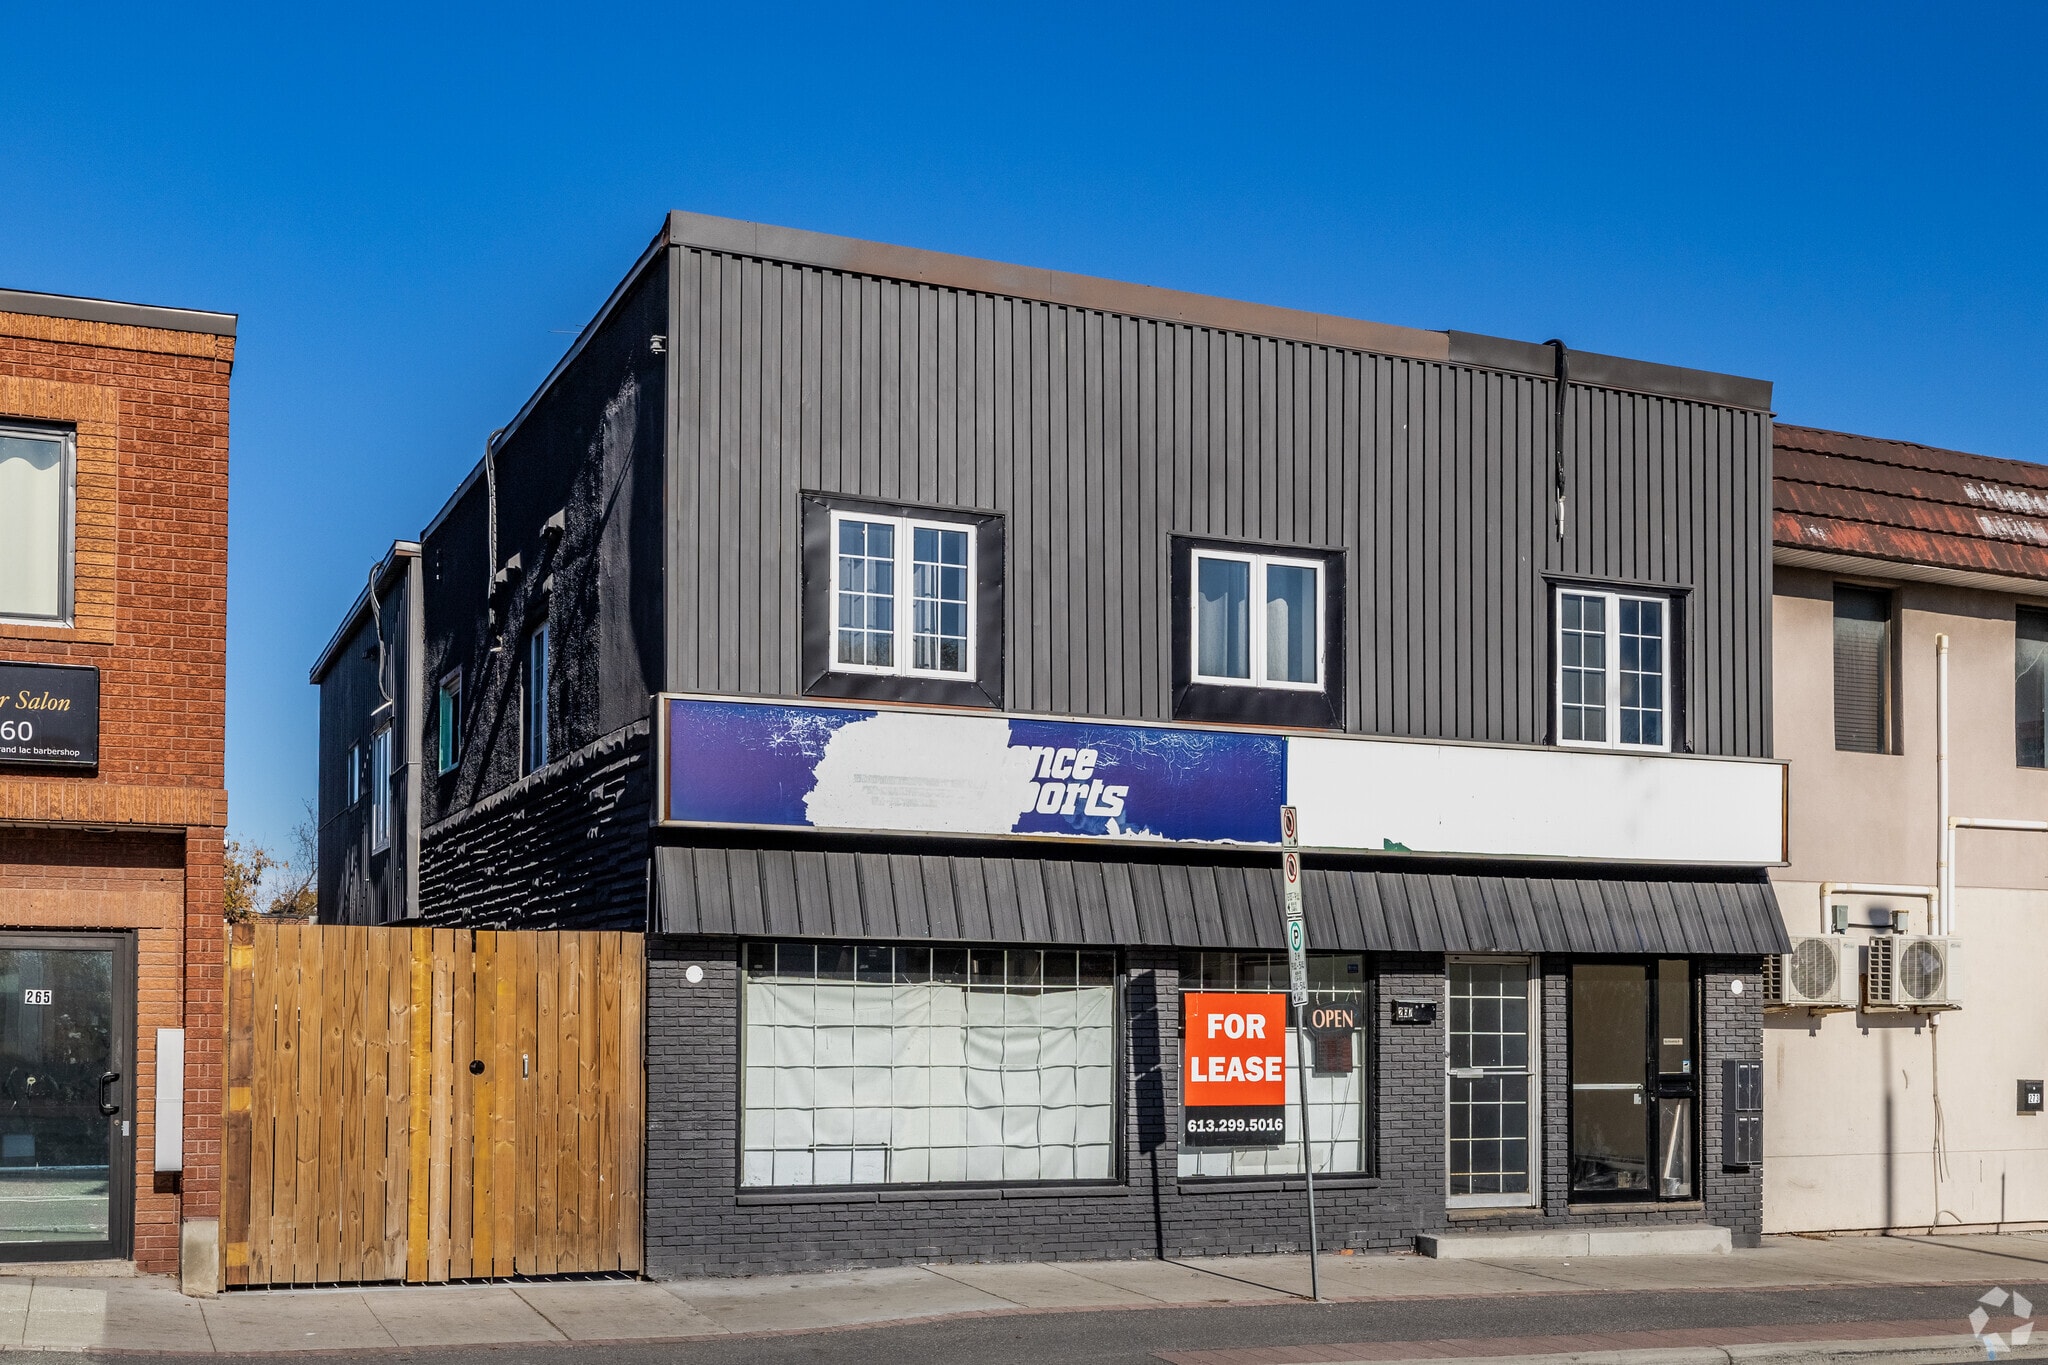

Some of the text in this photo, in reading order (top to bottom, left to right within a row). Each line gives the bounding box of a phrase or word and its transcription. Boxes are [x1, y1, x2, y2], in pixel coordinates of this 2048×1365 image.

[15, 690, 71, 712] Salon
[0, 720, 33, 741] 60
[19, 746, 31, 754] lac
[33, 747, 80, 758] barbershop
[26, 990, 50, 1004] 265
[1207, 1013, 1266, 1039] FOR
[1312, 1009, 1354, 1028] OPEN
[1191, 1056, 1283, 1082] LEASE
[1187, 1118, 1284, 1132] 613.299.5016
